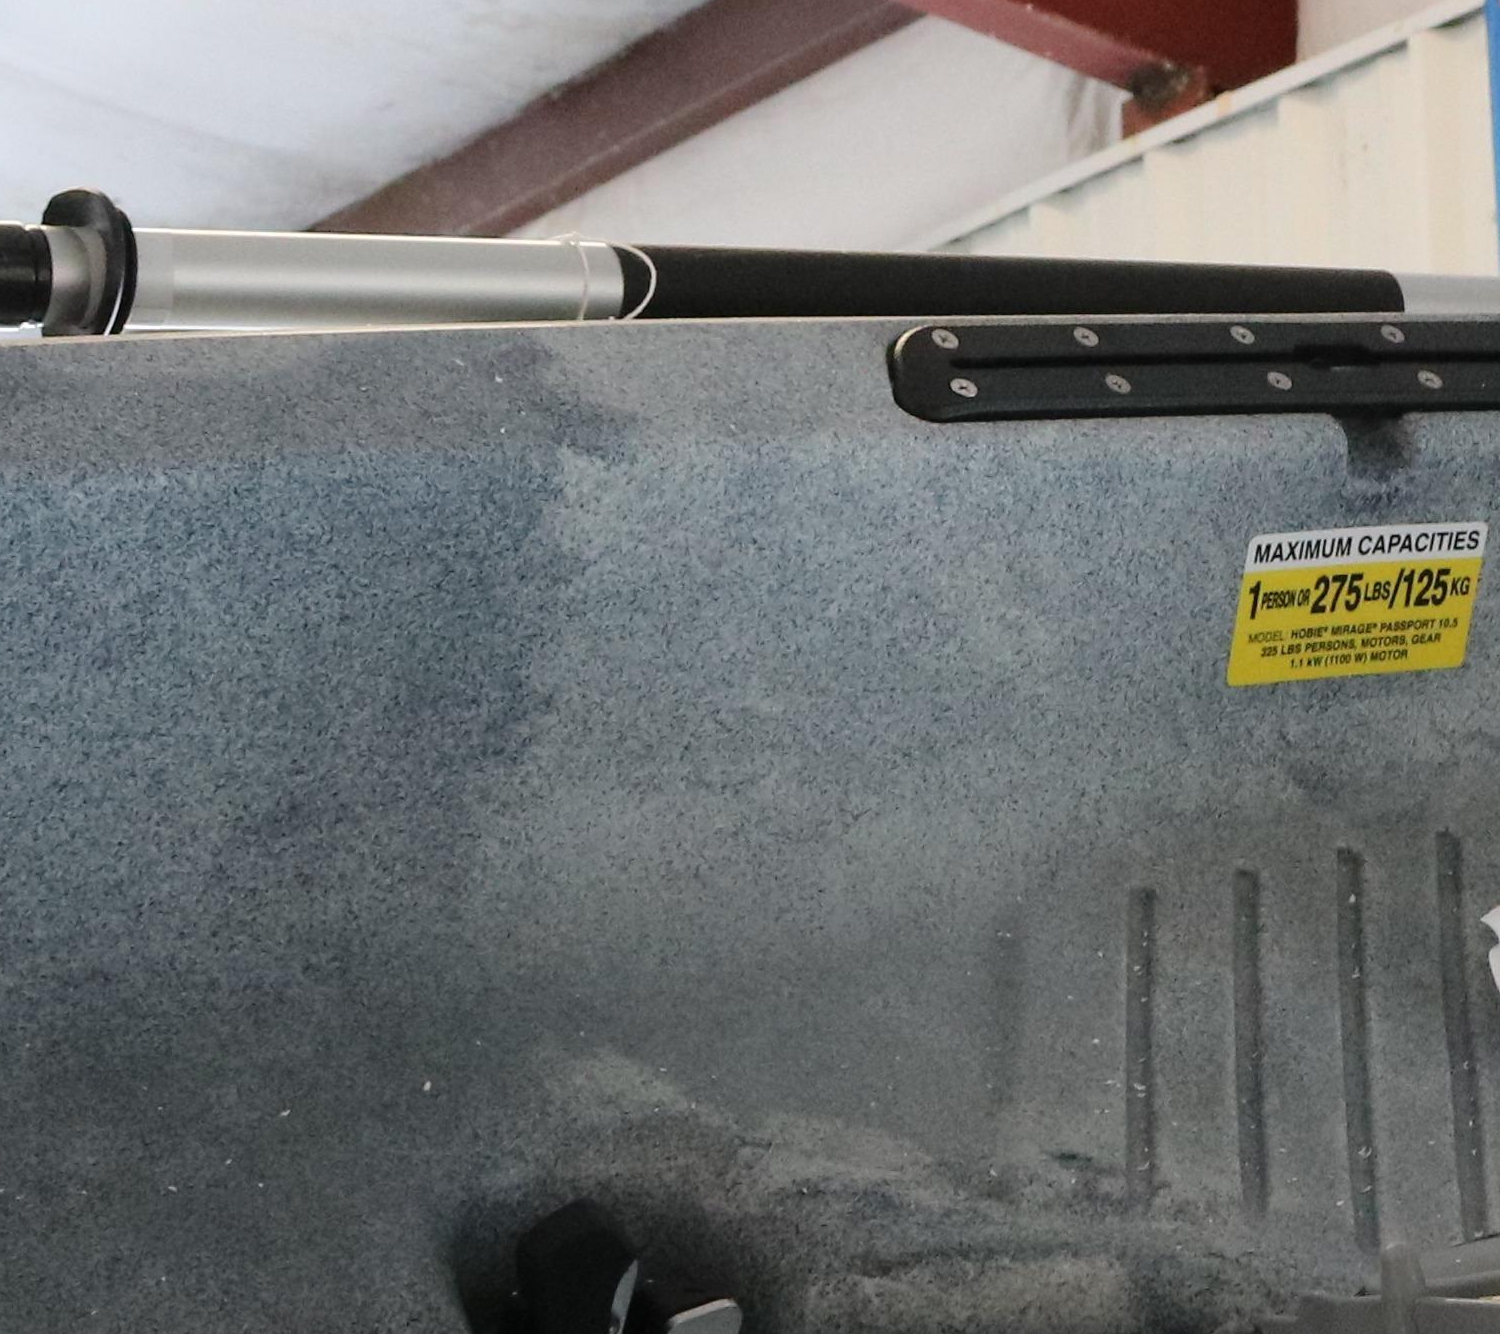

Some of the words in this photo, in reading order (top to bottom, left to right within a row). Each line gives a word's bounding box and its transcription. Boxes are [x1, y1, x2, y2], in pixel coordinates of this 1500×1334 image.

[1253, 536, 1353, 564] MAXIMUM
[1357, 530, 1480, 556] CAPACITIES
[1249, 580, 1262, 620] 1
[1260, 589, 1296, 610] PERSON
[1296, 588, 1311, 606] OR
[1310, 572, 1364, 615] 275
[1450, 576, 1471, 596] KG
[1380, 619, 1436, 633] PASSPORT
[1281, 643, 1301, 656] LBS
[1411, 633, 1442, 645] GEAR
[1370, 648, 1409, 662] MOTOR
